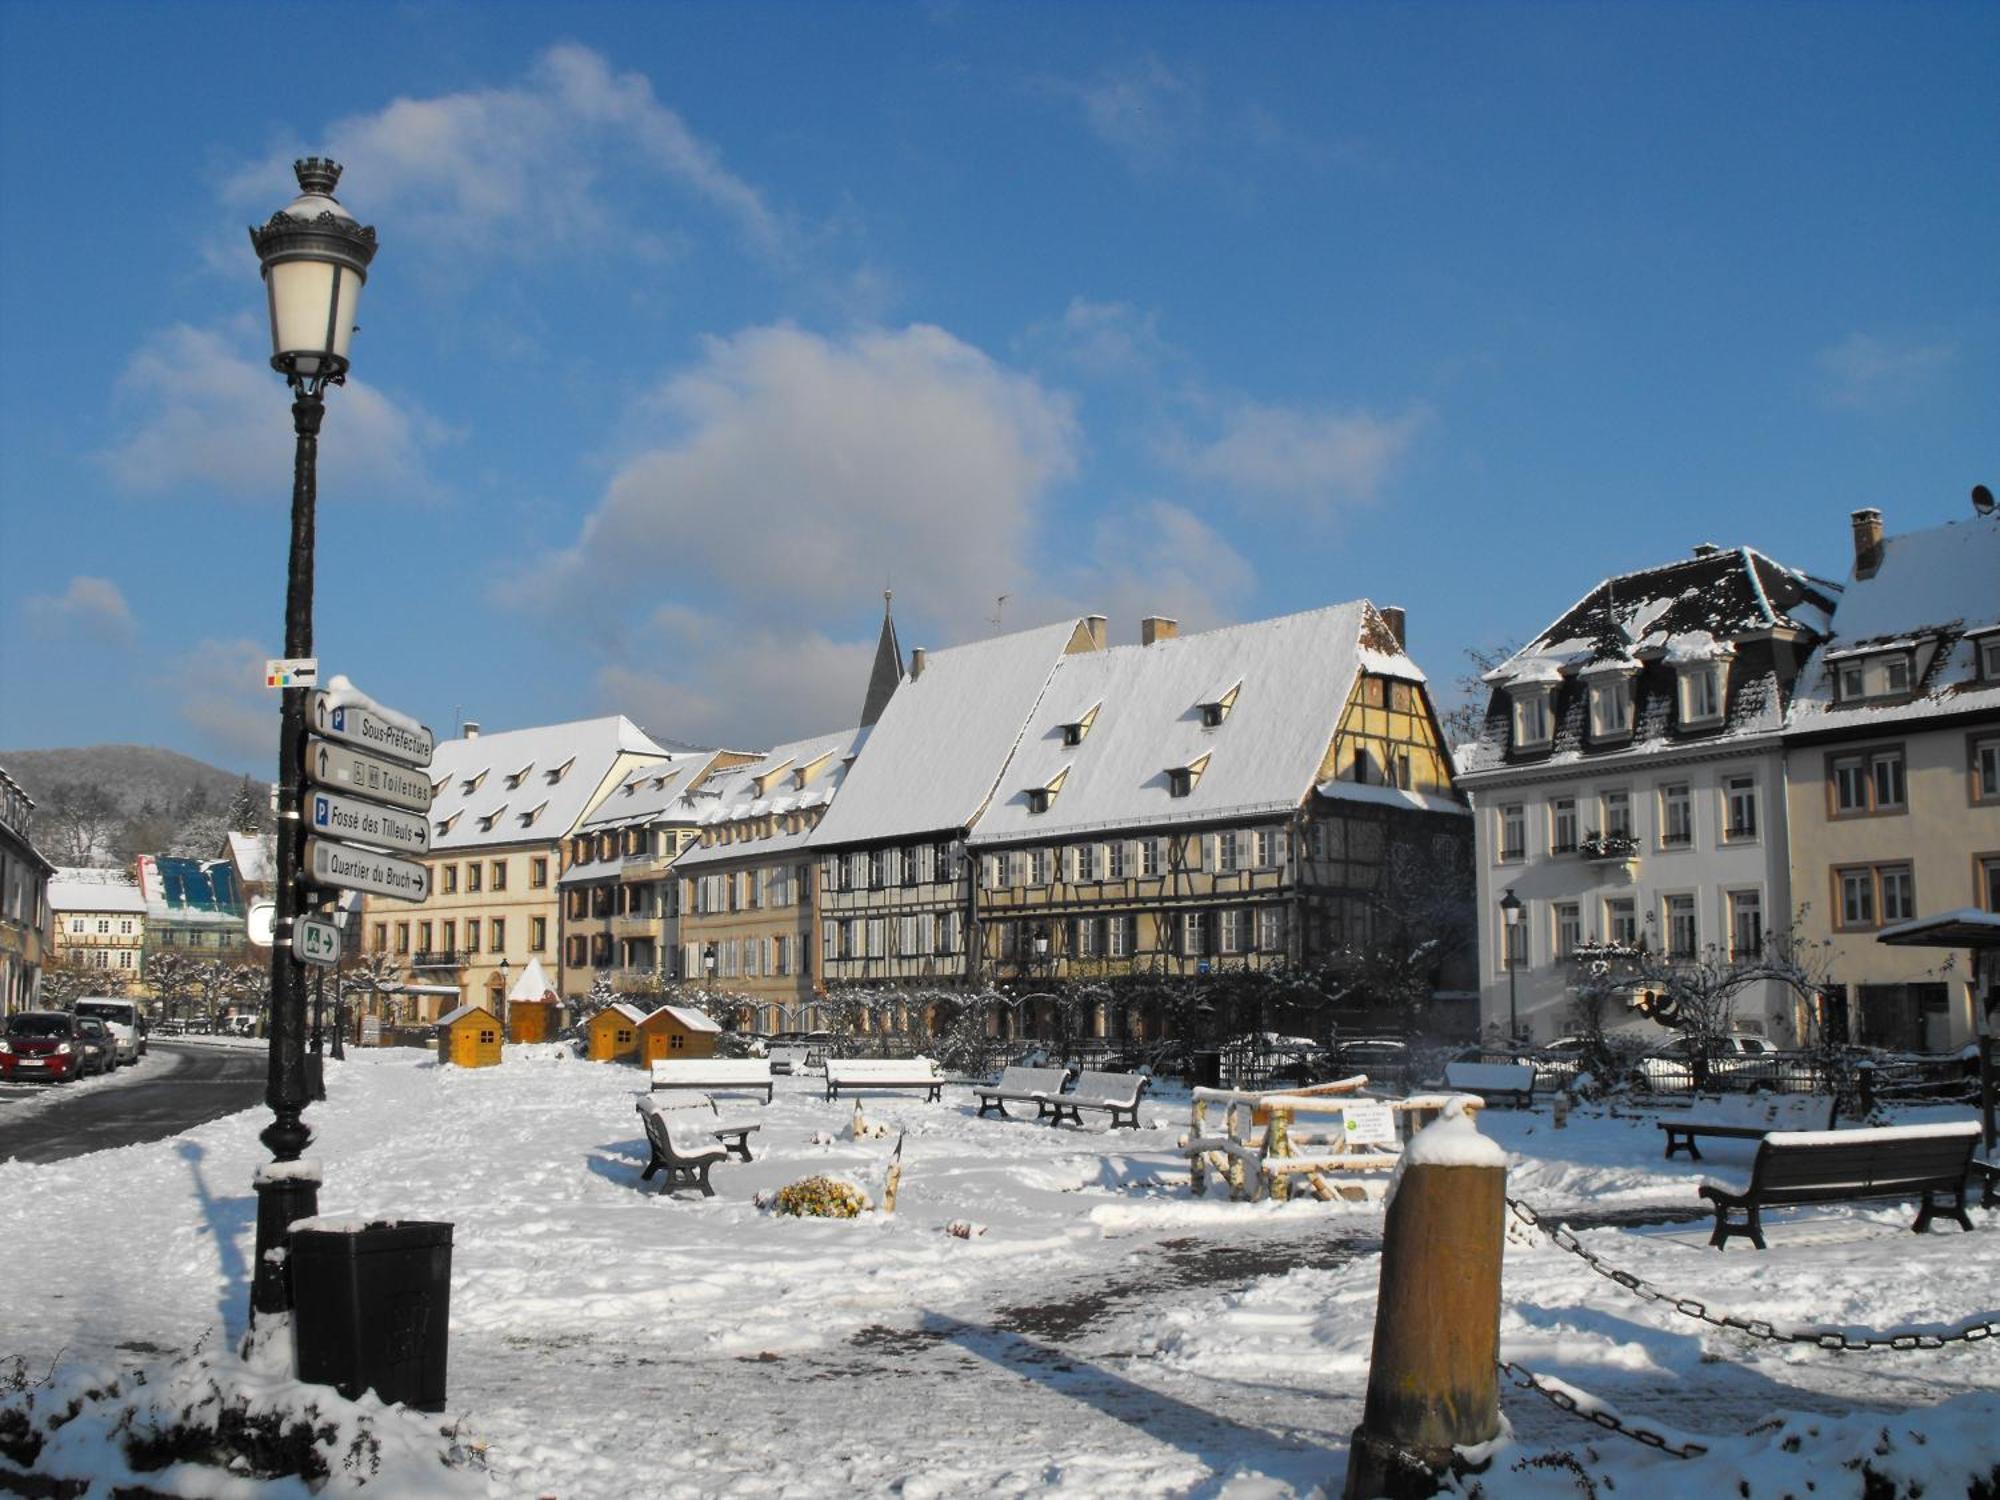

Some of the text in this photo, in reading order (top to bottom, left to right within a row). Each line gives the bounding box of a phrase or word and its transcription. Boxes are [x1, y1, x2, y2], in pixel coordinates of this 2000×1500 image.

[383, 771, 428, 801] Toilettes
[318, 802, 413, 842] P Fossé des Tilleuls
[331, 854, 410, 889] Quartier du Bruch
